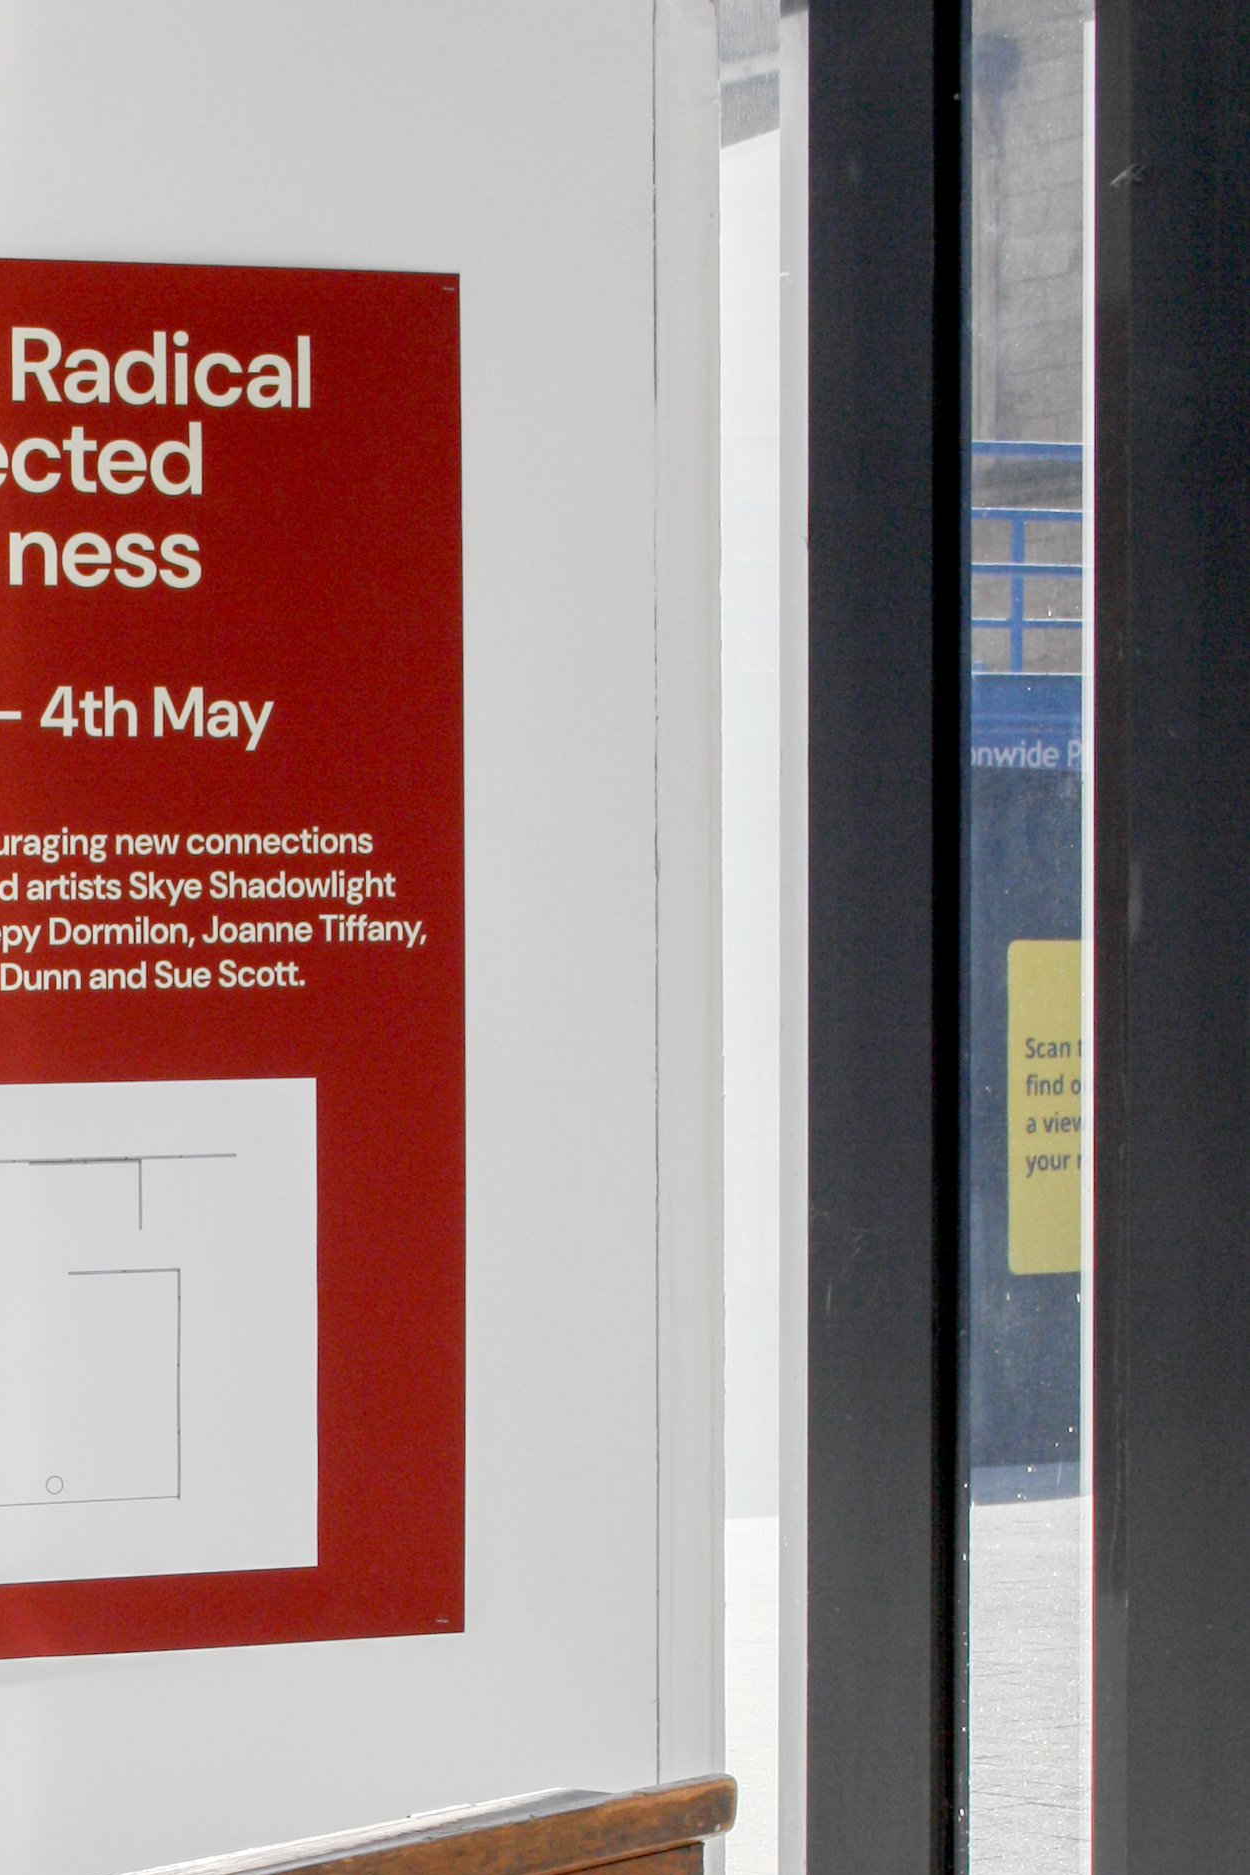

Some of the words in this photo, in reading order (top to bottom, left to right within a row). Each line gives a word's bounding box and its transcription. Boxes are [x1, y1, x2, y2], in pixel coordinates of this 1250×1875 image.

[12, 327, 310, 408] Radical
[9, 532, 201, 588] ness
[40, 686, 137, 737] 4th
[154, 687, 274, 751] May
[116, 834, 179, 855] new
[187, 826, 373, 854] connections
[27, 872, 122, 901] artists
[129, 871, 202, 906] Skye
[210, 870, 396, 905] Shadowlight
[49, 916, 195, 948] Dormilon,
[202, 916, 313, 943] Joanne
[319, 914, 426, 948] Tiffany,
[0, 963, 81, 991] Dunn
[89, 961, 146, 990] and
[155, 960, 211, 989] Sue
[219, 959, 305, 987] Scott.
[1025, 1037, 1071, 1059] Scan
[1026, 1073, 1064, 1096] find
[1026, 1116, 1037, 1134] a
[1025, 1154, 1070, 1179] your
